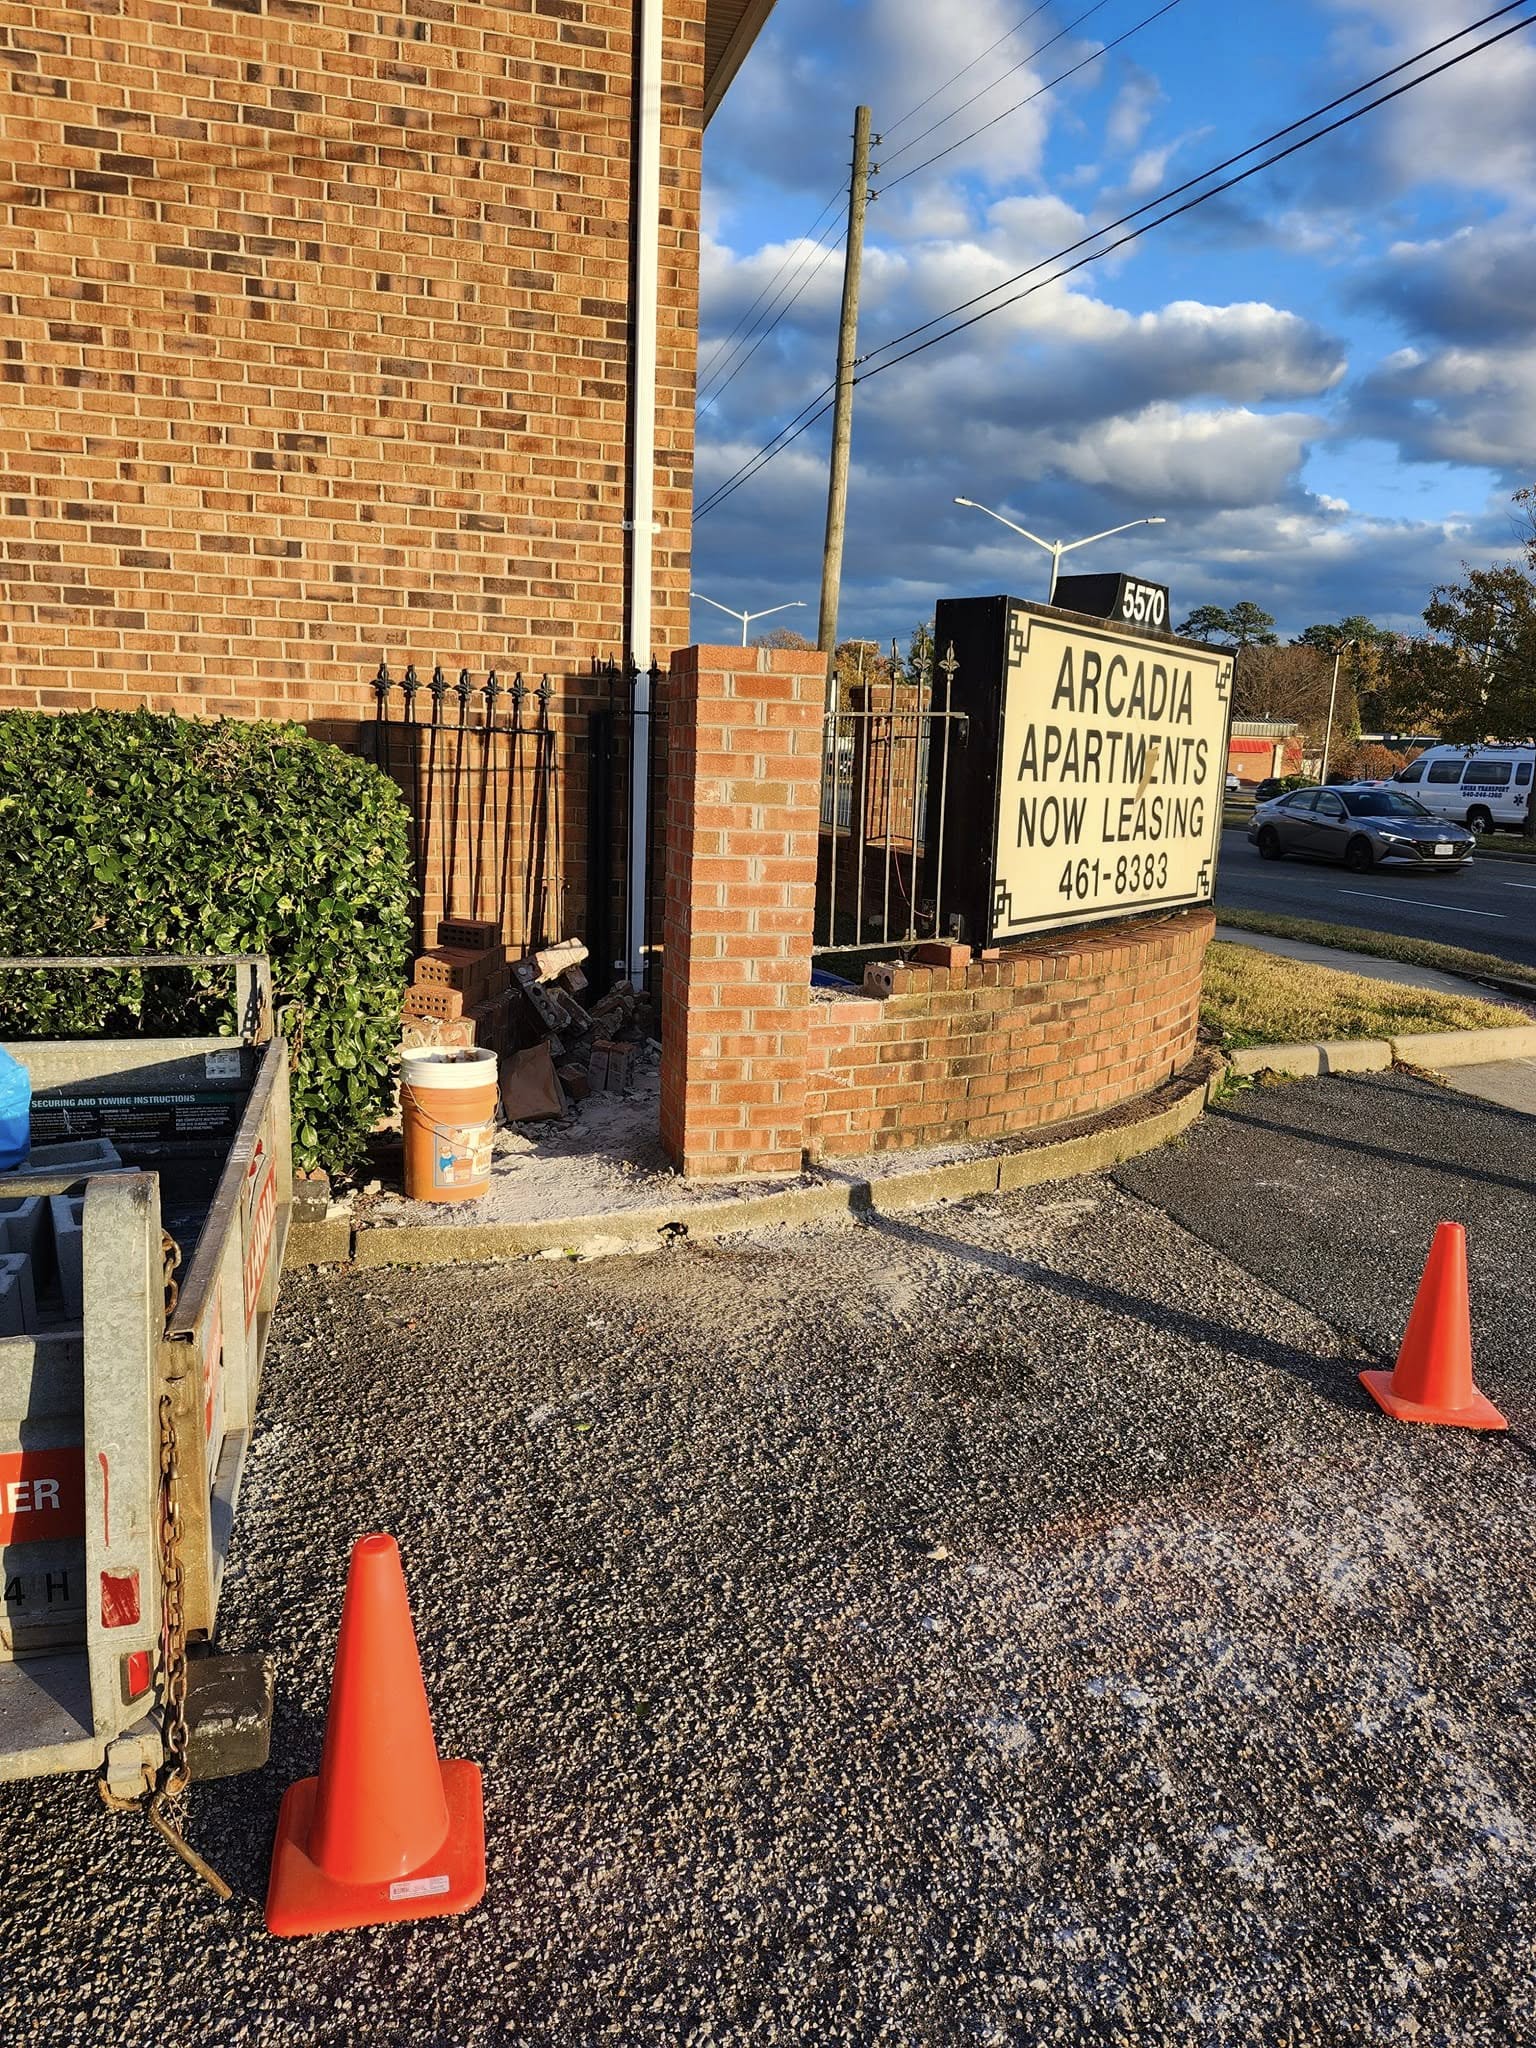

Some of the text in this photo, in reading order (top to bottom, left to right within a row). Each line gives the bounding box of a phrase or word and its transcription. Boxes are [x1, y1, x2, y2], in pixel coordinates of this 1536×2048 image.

[1122, 582, 1165, 626] 5570
[1051, 646, 1193, 725] ARCADIA
[1017, 723, 1208, 785] APARTMENTS
[1016, 796, 1204, 848] NOW LEASING
[1059, 852, 1168, 900] 461-8383
[31, 1094, 196, 1108] SECURING AND TOWING INSTRUCTIONS
[0, 1479, 60, 1515] ER
[0, 1570, 70, 1606] 4 H
